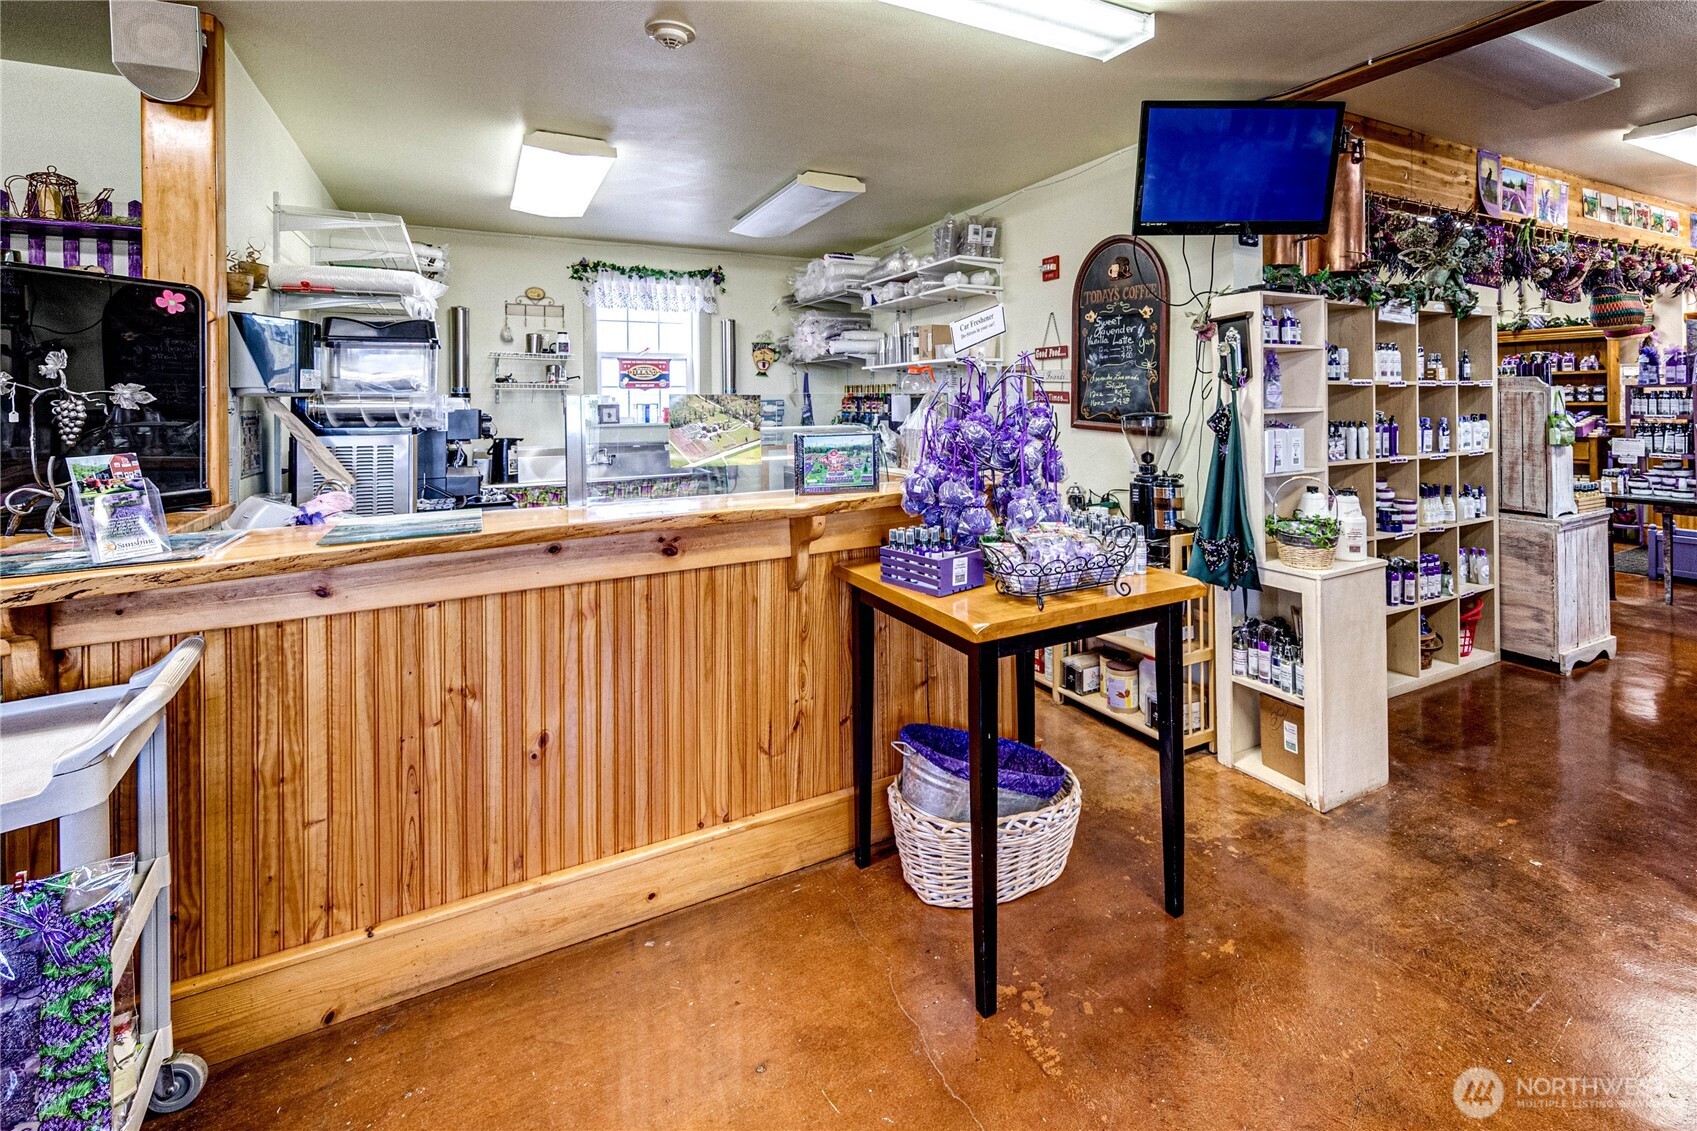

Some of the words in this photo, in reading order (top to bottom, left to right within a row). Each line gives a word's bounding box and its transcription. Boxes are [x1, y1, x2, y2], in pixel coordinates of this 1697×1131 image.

[1083, 285, 1120, 305] TODAY'S
[1122, 283, 1158, 300] COFFEE
[960, 323, 970, 332] Car
[969, 313, 995, 328] Freshener
[1094, 315, 1122, 328] Sweet
[1093, 324, 1137, 338] Lavender
[1112, 334, 1134, 346] Latte
[1035, 349, 1048, 359] Good
